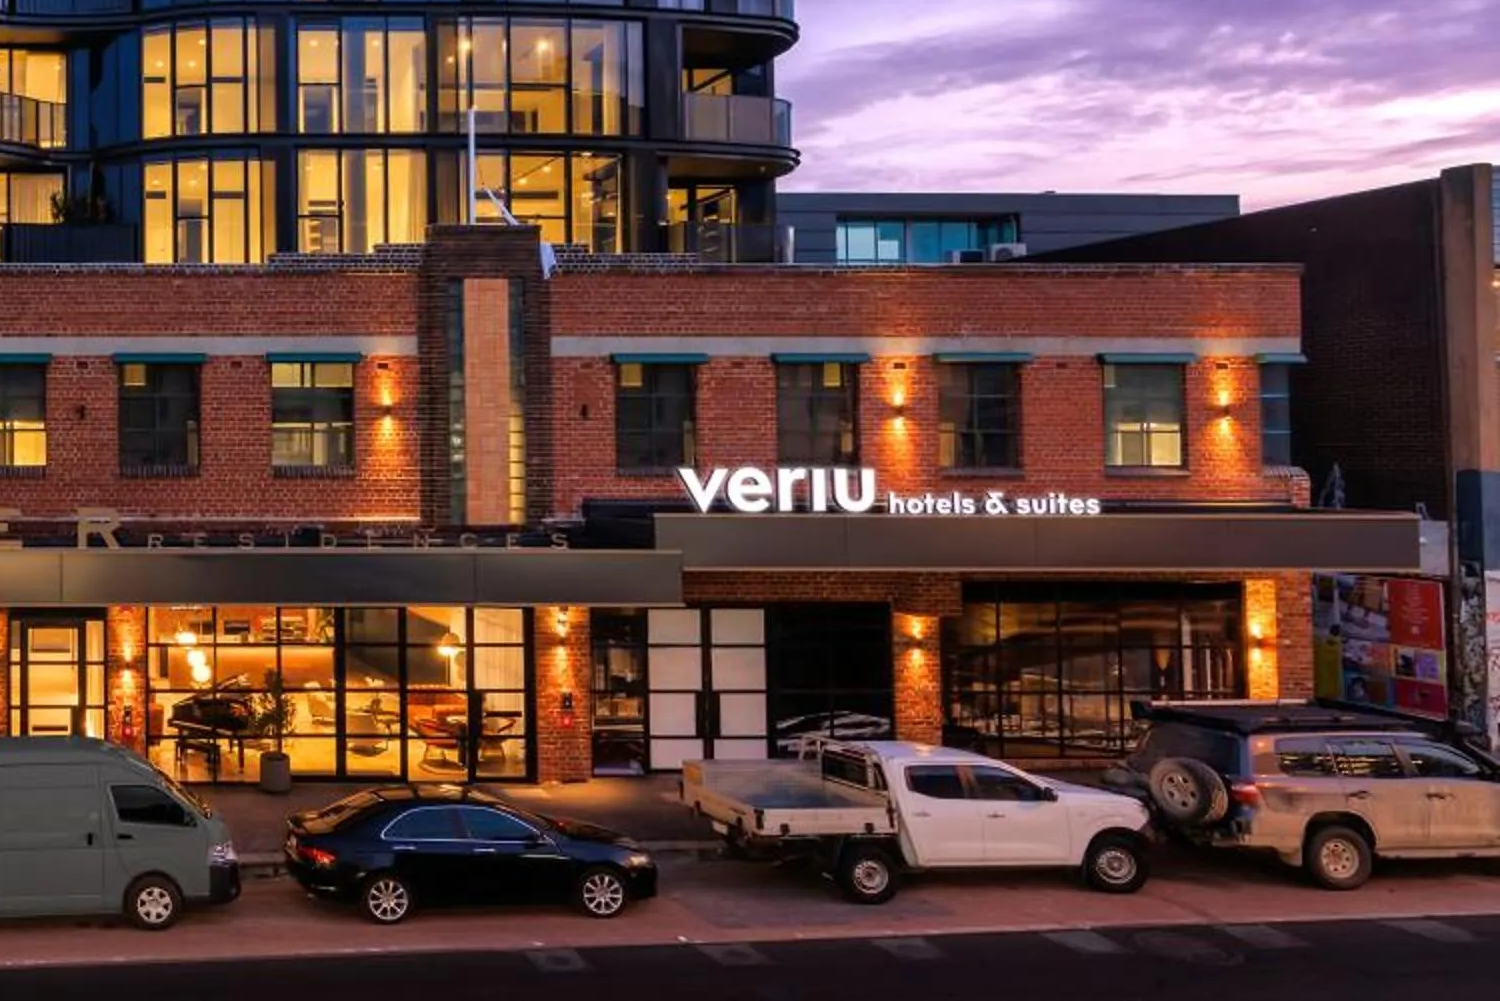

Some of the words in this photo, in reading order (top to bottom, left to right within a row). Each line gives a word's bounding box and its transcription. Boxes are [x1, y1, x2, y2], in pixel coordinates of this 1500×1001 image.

[678, 466, 876, 514] veriu
[889, 491, 976, 515] hotels
[985, 490, 1009, 515] &
[1016, 492, 1100, 515] suites
[147, 532, 570, 550] RESIDENCES
